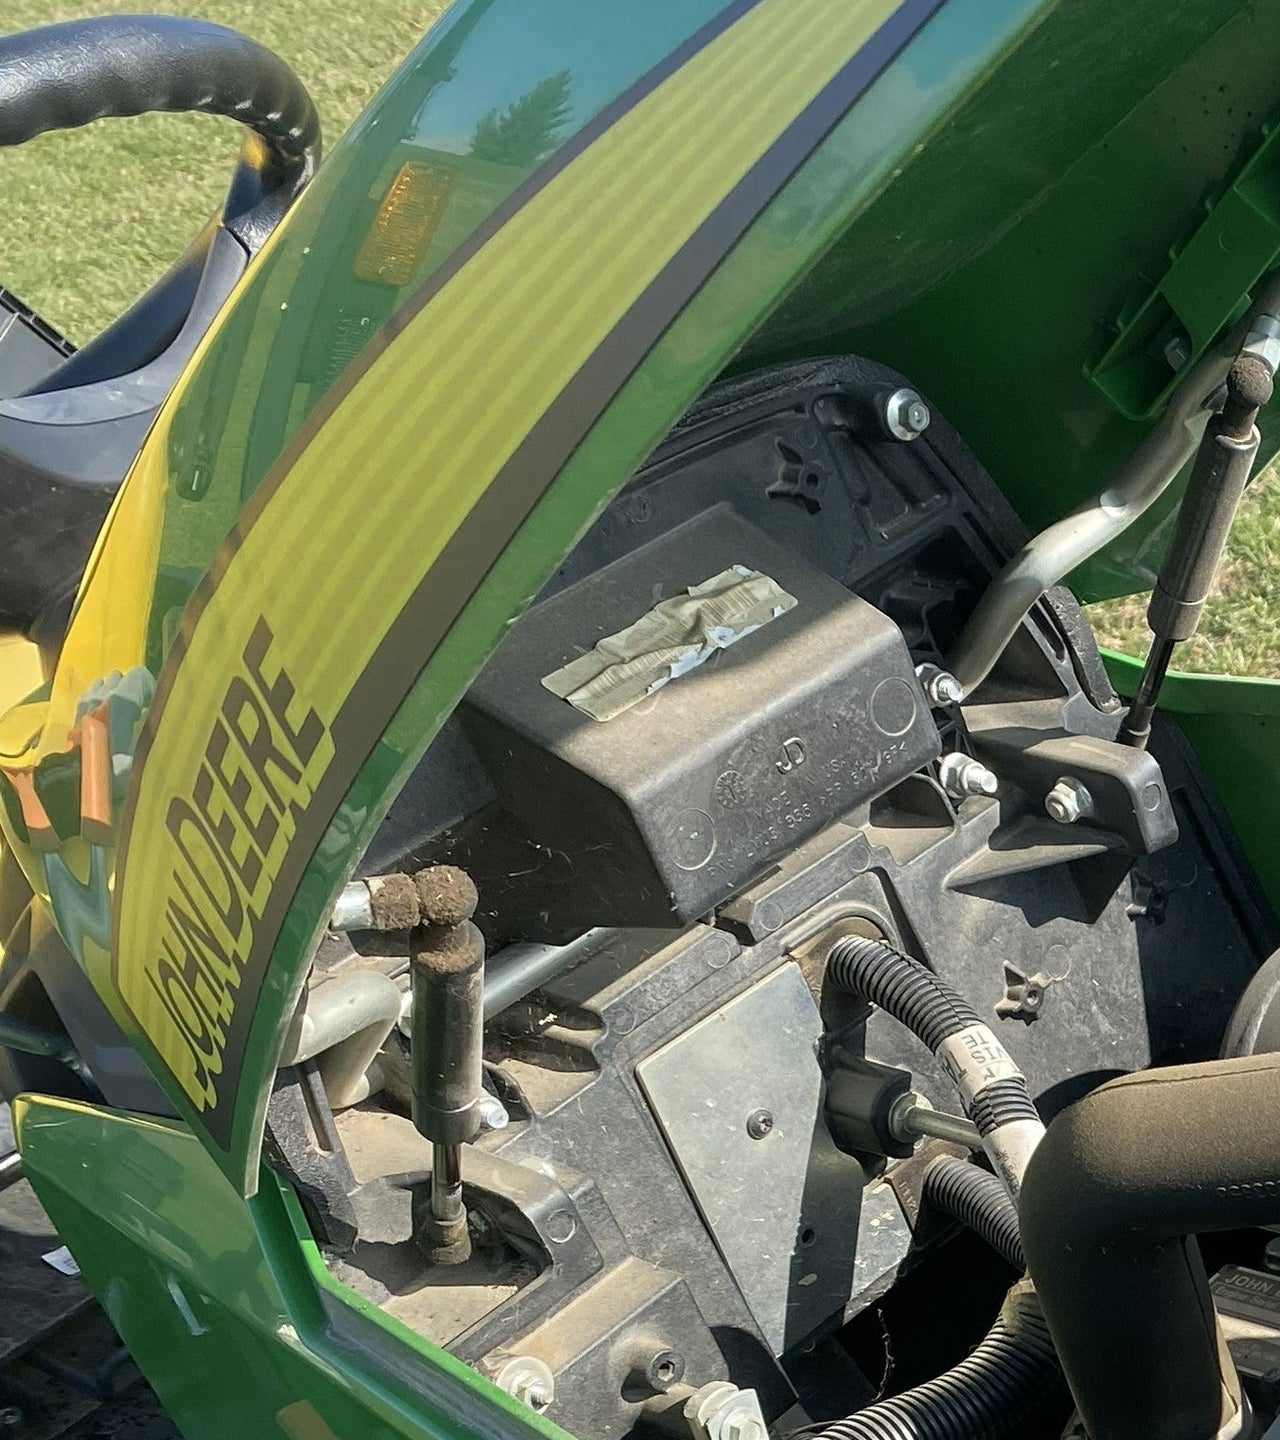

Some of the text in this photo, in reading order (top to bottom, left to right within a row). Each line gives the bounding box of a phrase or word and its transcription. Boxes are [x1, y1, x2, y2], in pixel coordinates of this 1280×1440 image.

[144, 612, 336, 1113] JOHN DEERE
[1224, 1274, 1274, 1294] JOHN
